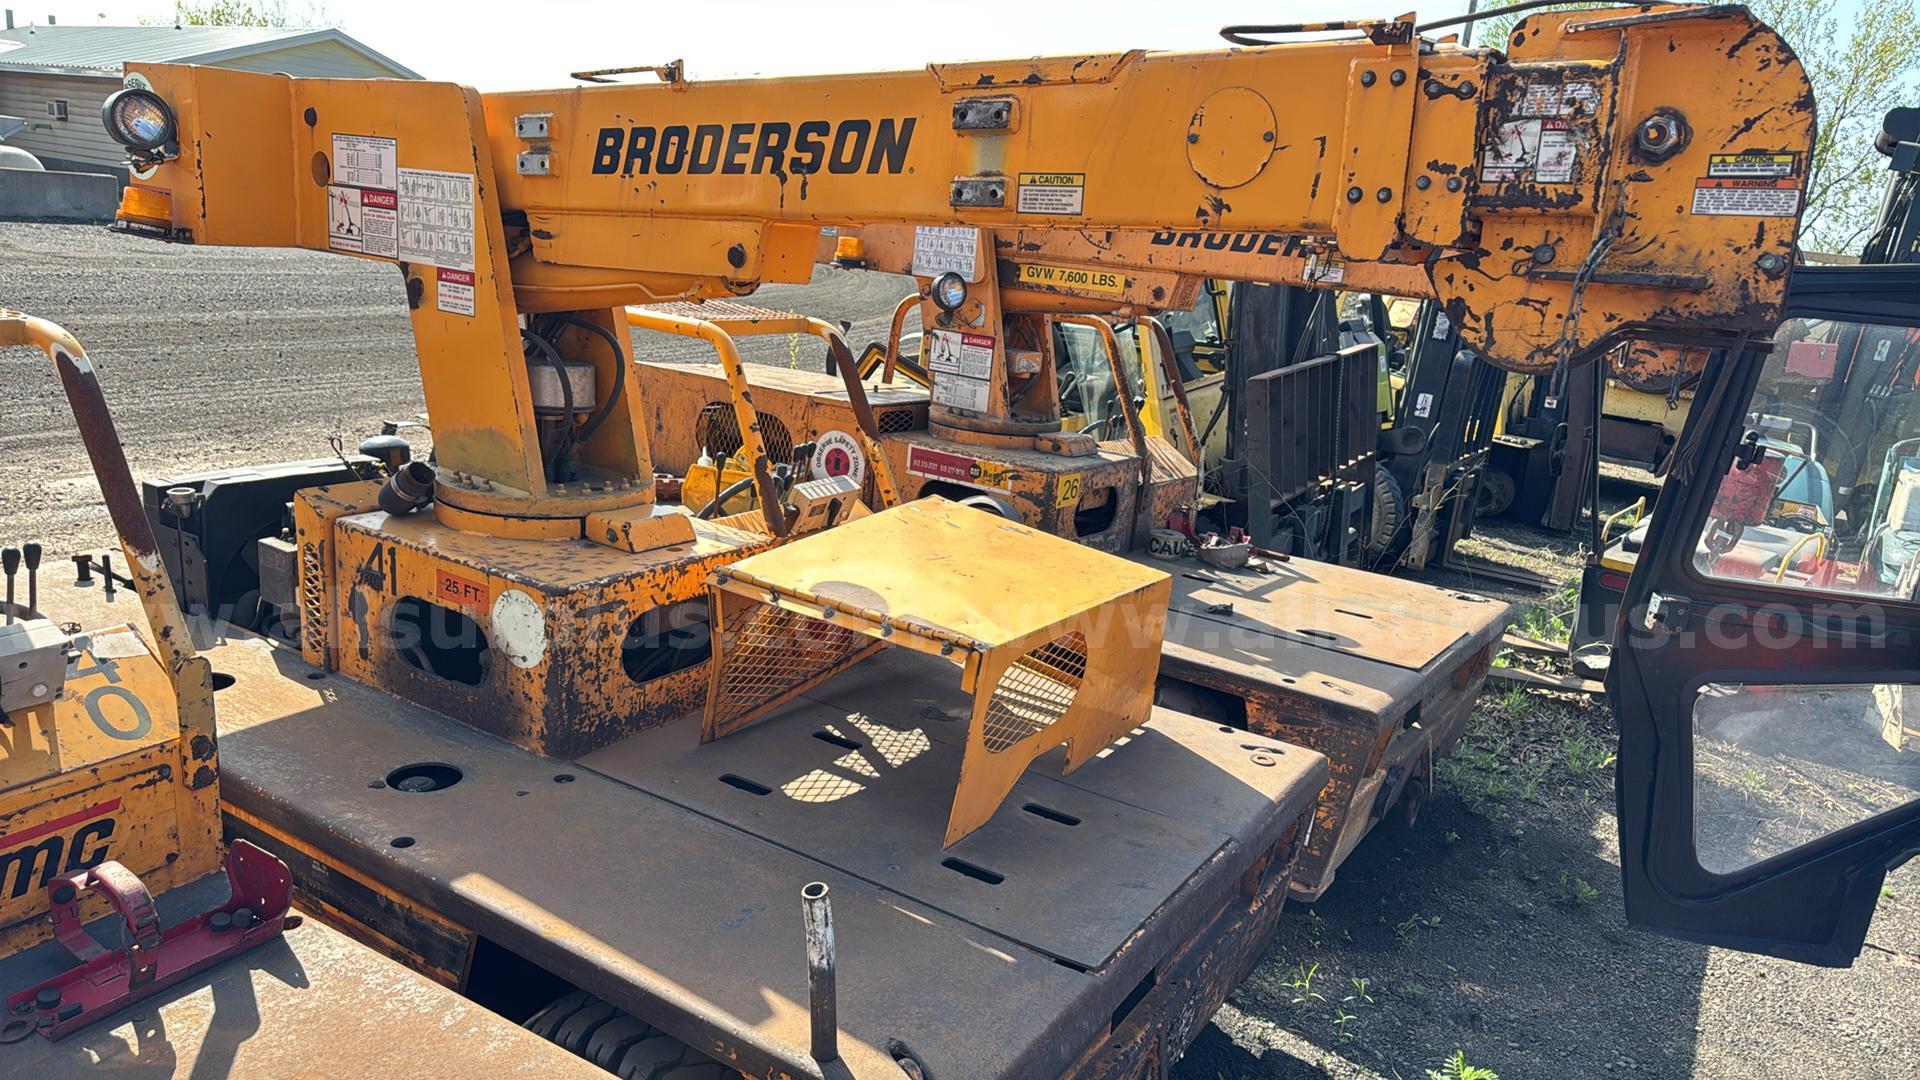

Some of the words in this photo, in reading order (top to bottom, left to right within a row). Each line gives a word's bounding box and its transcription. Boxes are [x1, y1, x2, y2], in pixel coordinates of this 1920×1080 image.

[591, 117, 917, 175] BRODERSON
[1038, 175, 1074, 185] CAUTION
[1732, 180, 1778, 188] WARNING
[367, 194, 395, 206] DANGER
[446, 271, 471, 283] DANGER
[1026, 265, 1054, 281] GVW
[1058, 267, 1088, 286] 7,600
[1092, 271, 1118, 288] LBS.
[968, 337, 992, 345] DANGER
[815, 437, 833, 468] OBSERVE
[834, 435, 857, 454] SAFETY
[851, 455, 860, 478] ZONE
[1063, 477, 1078, 500] 26
[364, 542, 397, 596] 41
[444, 577, 459, 595] 25
[464, 584, 482, 603] FT.
